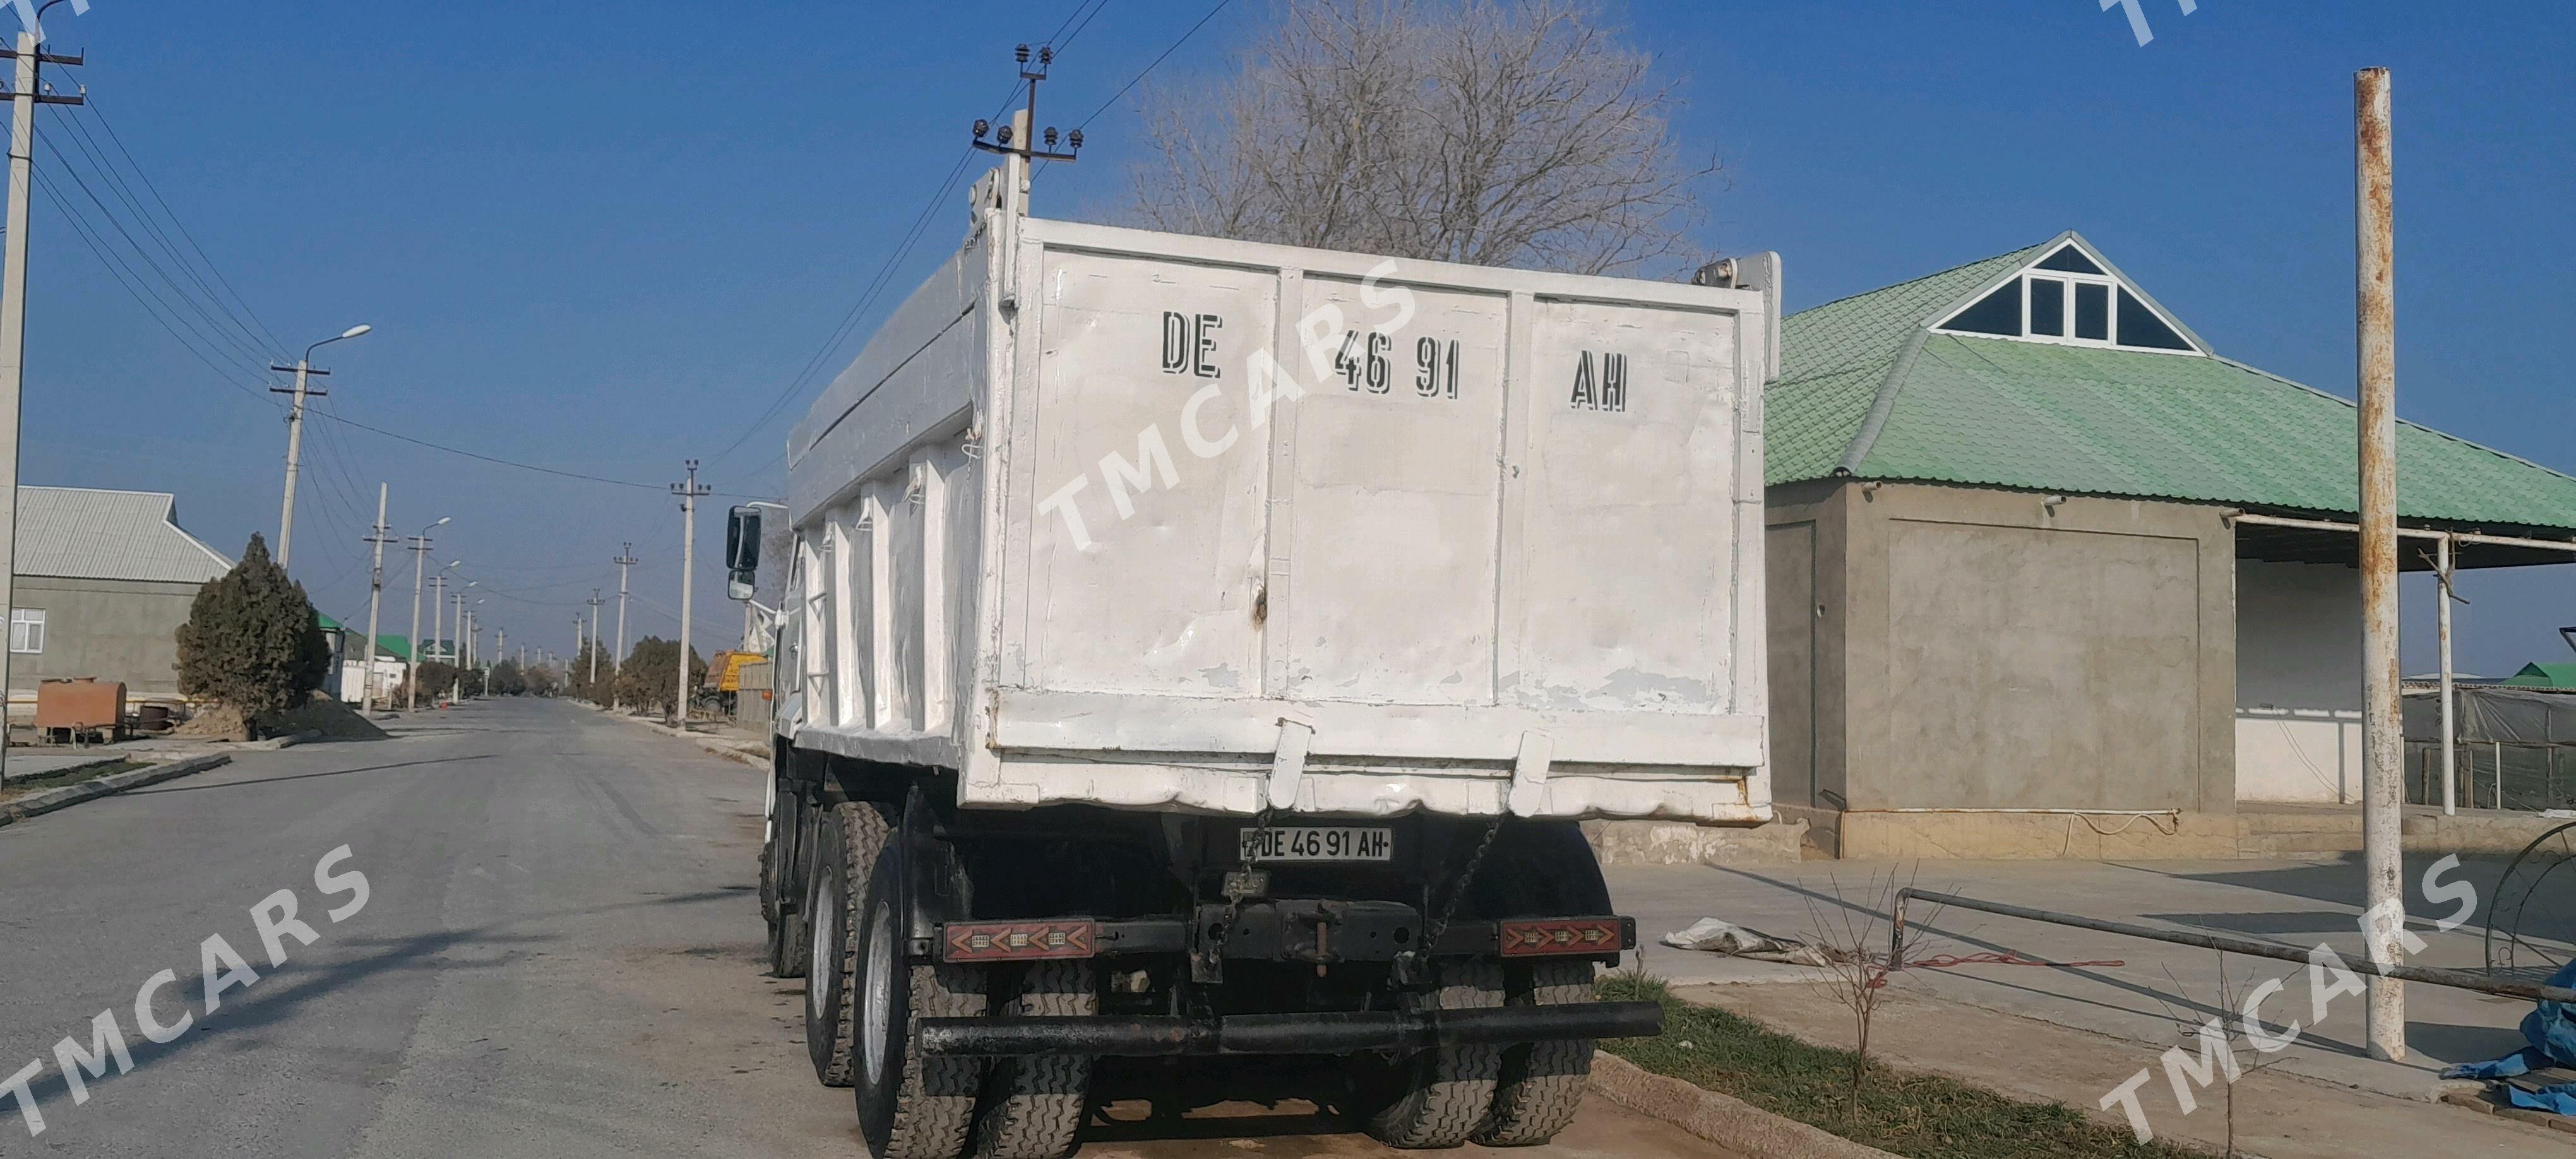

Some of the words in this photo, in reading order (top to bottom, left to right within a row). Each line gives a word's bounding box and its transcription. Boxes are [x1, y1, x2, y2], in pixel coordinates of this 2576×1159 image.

[1162, 311, 1223, 379] DE
[1335, 330, 1392, 395] 46
[1416, 336, 1459, 400] 91
[1570, 350, 1627, 412] AH
[1262, 831, 1285, 857] DE
[1291, 830, 1321, 857] 46
[1326, 830, 1351, 857] 91
[1357, 831, 1383, 857] AH
